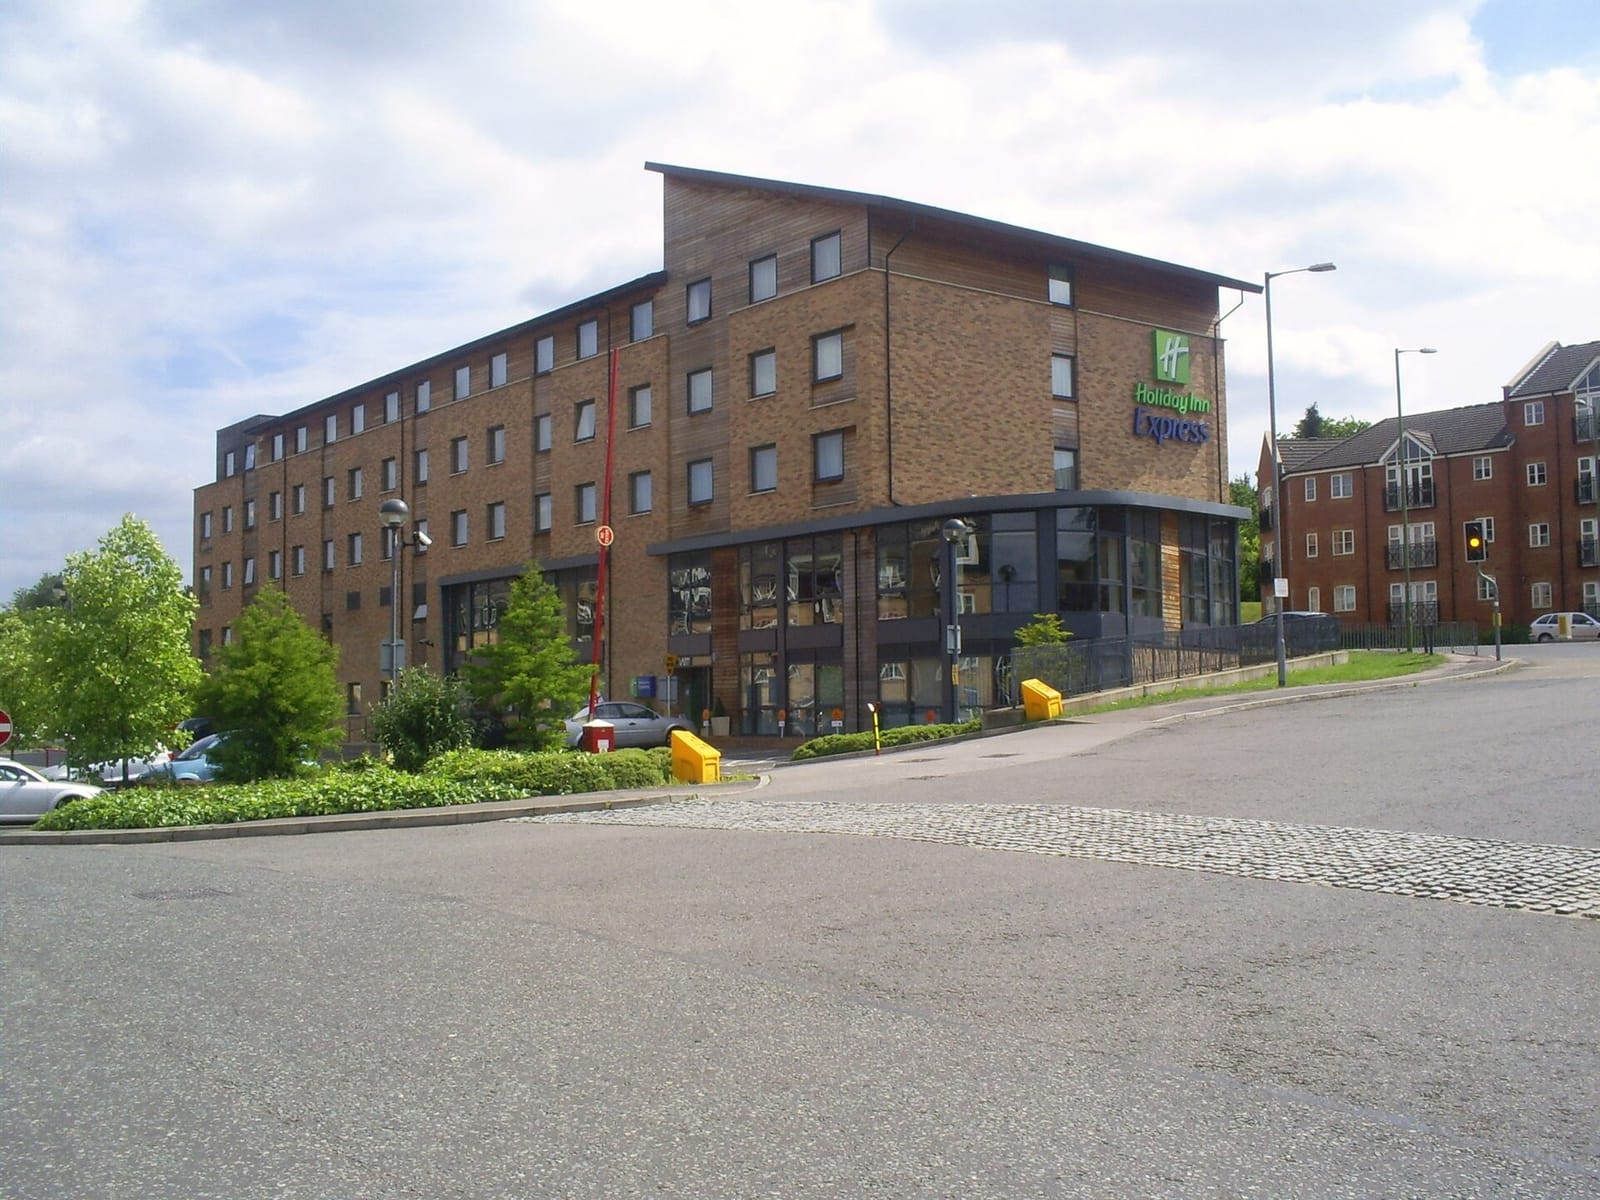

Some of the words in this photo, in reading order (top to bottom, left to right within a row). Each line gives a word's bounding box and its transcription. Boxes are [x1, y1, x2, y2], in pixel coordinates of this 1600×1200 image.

[1136, 382, 1188, 415] Holiday
[1190, 391, 1210, 413] Inn
[1134, 406, 1210, 445] Express
